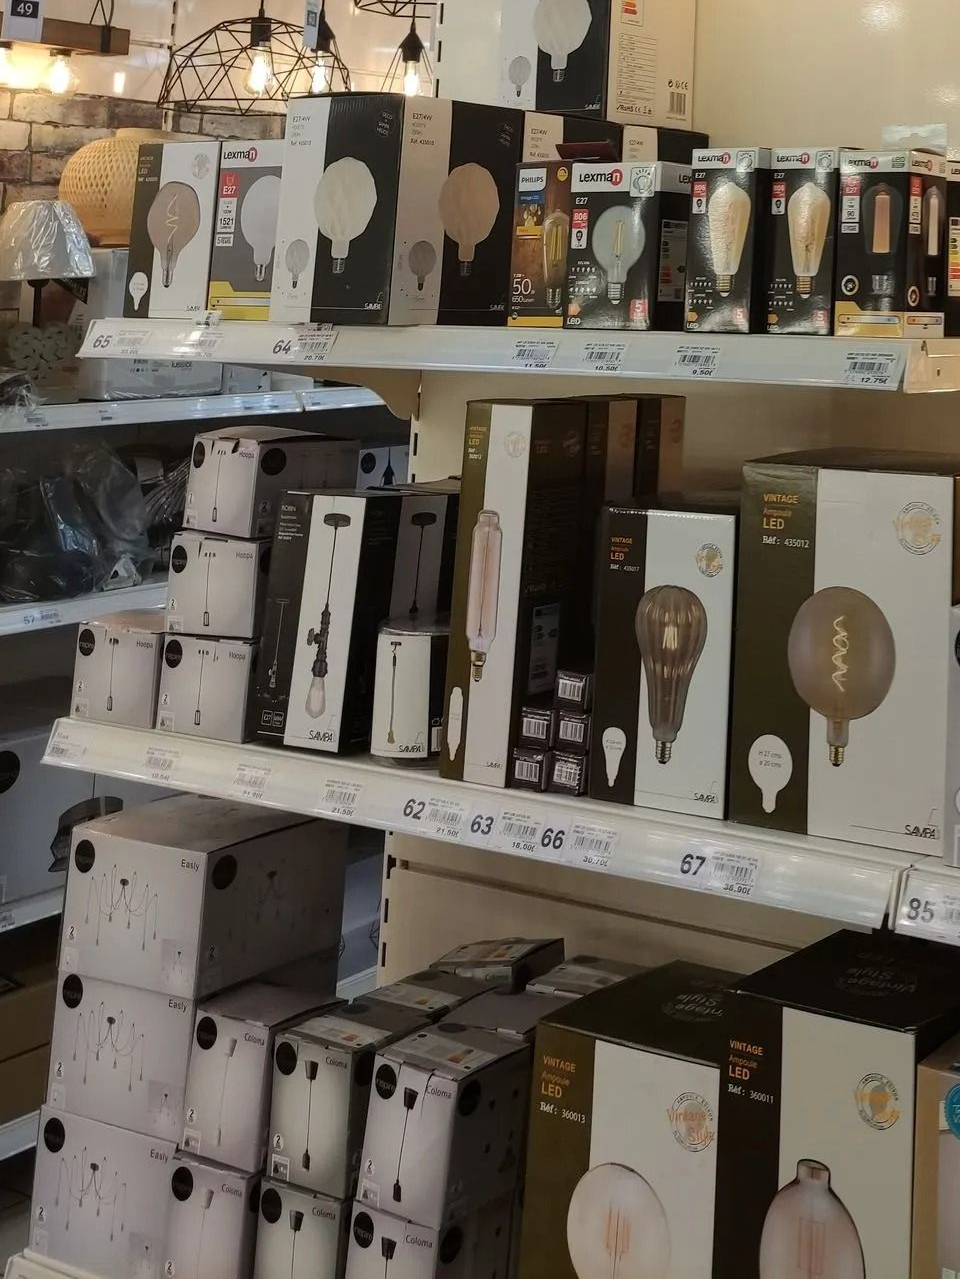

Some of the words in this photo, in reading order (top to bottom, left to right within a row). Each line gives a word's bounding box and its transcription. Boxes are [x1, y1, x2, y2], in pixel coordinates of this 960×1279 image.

[17, 3, 33, 16] 49
[223, 147, 258, 162] Lexman
[697, 151, 731, 164] Lexman
[776, 151, 810, 164] Lexman
[521, 176, 544, 184] PHILIPS
[579, 168, 624, 187] Lexman
[223, 185, 237, 195] E27
[575, 197, 589, 205] E27
[219, 218, 234, 226] 1521
[573, 212, 588, 220] 806
[635, 300, 643, 312] 5
[736, 310, 743, 320] 5
[816, 310, 824, 321] 5
[93, 335, 112, 349] 65
[272, 339, 293, 354] 64
[468, 438, 480, 446] LED
[239, 450, 255, 460] Hoopa
[763, 493, 799, 505] VINTAGE
[763, 517, 785, 530] LED
[611, 537, 633, 545] VINTAGE
[784, 537, 810, 548] 435012
[236, 552, 253, 560] Hoopa
[610, 552, 625, 561] LED
[136, 640, 154, 650] Hoopa
[228, 651, 247, 661] Hoopa
[309, 730, 335, 742] SAMPA
[403, 798, 426, 820] 62
[470, 814, 495, 836] 63
[541, 827, 566, 850] 66
[904, 824, 936, 840] SAMPA
[181, 858, 200, 871] Easly
[680, 853, 706, 876] 67
[906, 897, 935, 923] 85
[69, 926, 75, 936] 2
[209, 947, 215, 957] 2
[168, 999, 188, 1012] Easly
[675, 1003, 724, 1018] intage
[244, 1032, 265, 1046] Coloma
[729, 1039, 764, 1056] VINTAGE
[56, 1062, 63, 1072] 2
[326, 1057, 348, 1069] Coloma
[543, 1055, 577, 1073] VINTAGE
[728, 1053, 758, 1069] Ampoule
[541, 1071, 570, 1086] Ampoule
[728, 1065, 750, 1081] LED
[426, 1085, 452, 1099] Coloma
[541, 1081, 563, 1099] LED
[750, 1090, 775, 1104] 360011
[189, 1108, 195, 1118] 2
[561, 1108, 586, 1124] 360013
[276, 1135, 281, 1144] 2
[150, 1148, 169, 1163] Easly
[367, 1160, 373, 1170] 2
[221, 1183, 243, 1198] Coloma
[39, 1207, 44, 1217] 2
[312, 1207, 336, 1220] Coloma
[405, 1234, 433, 1248] Coloma
[167, 1261, 173, 1272] 2
